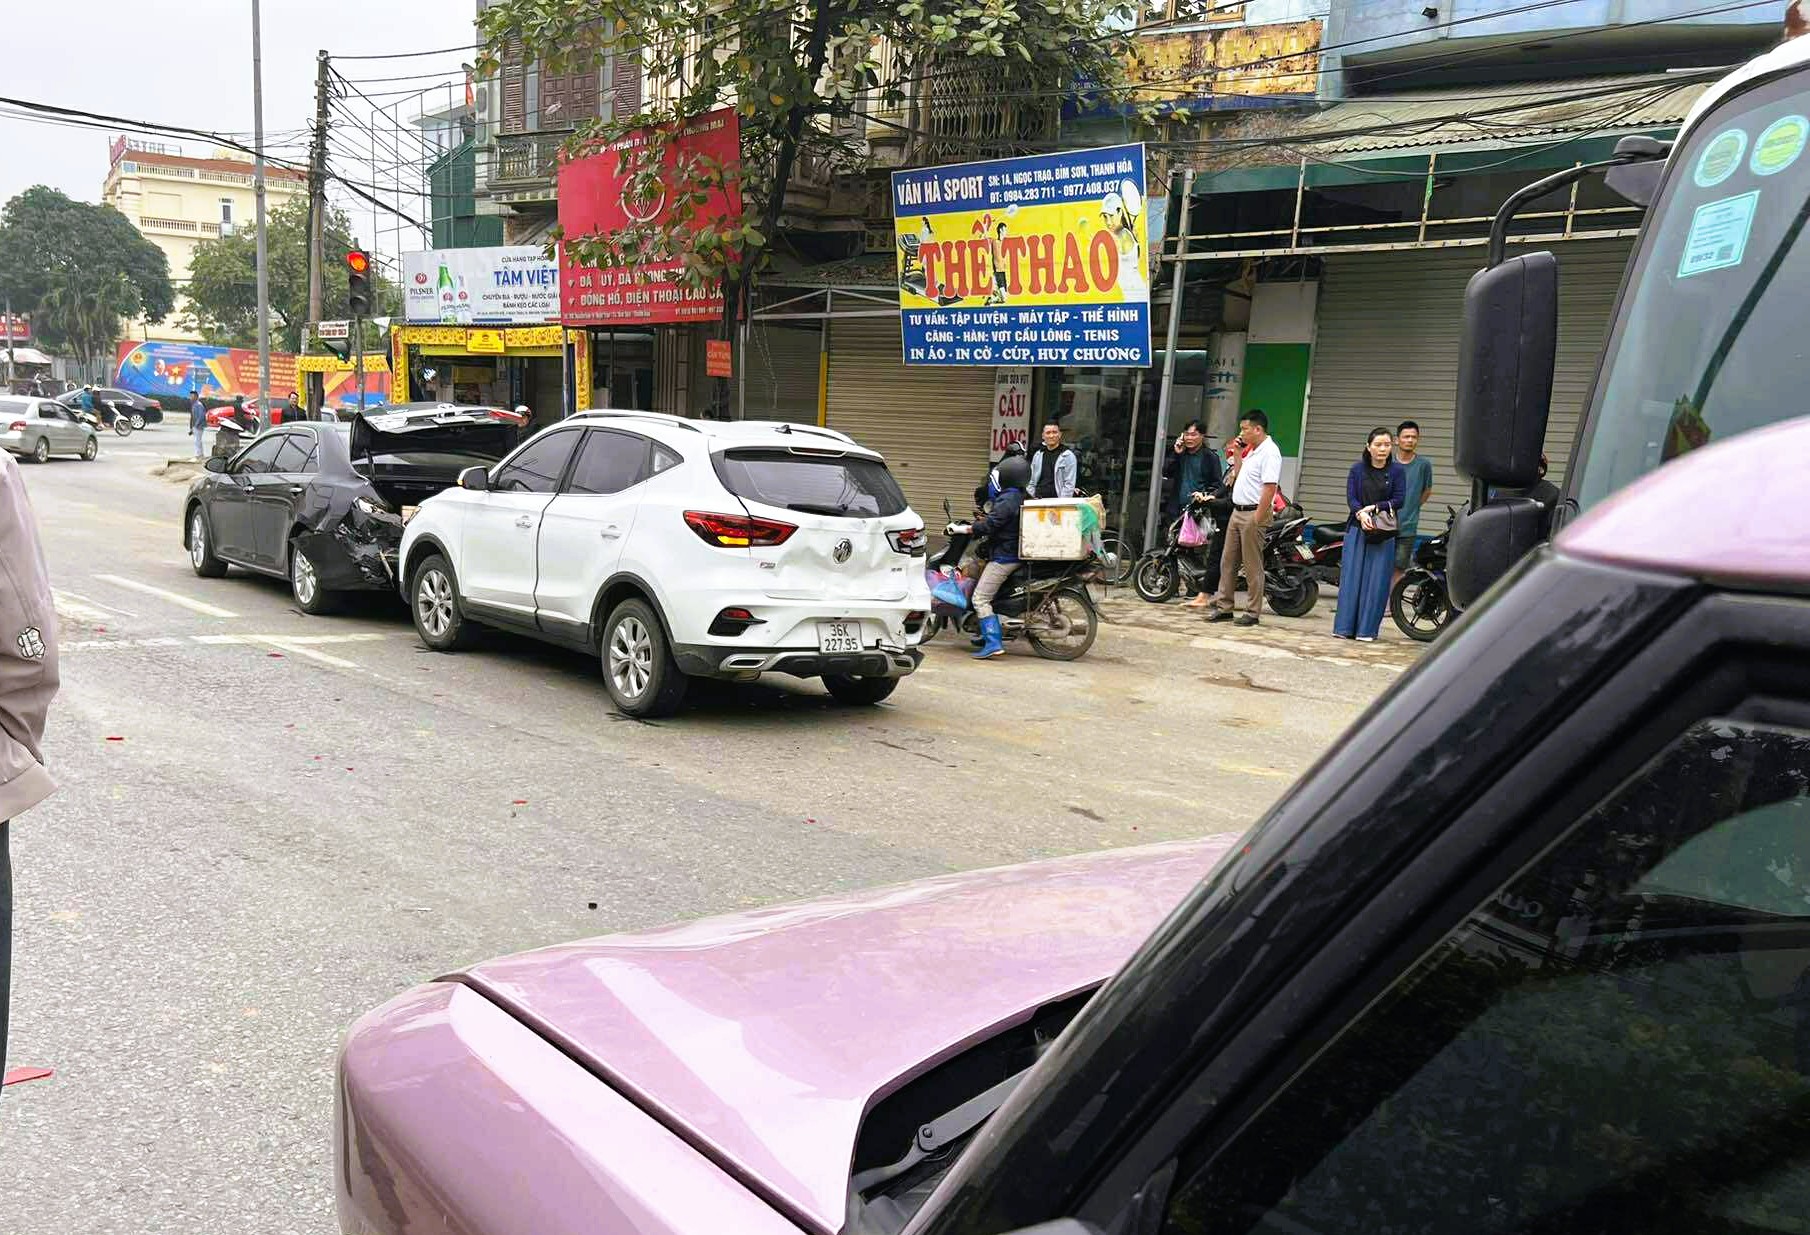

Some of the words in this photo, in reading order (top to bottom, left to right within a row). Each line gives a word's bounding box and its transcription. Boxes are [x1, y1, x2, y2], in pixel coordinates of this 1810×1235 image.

[988, 175, 1000, 187] SN:
[1002, 173, 1012, 185] 1A,
[1014, 170, 1032, 186] NGỌC
[1034, 170, 1054, 184] TRẠO,
[1071, 165, 1089, 179] SƠN,
[1090, 162, 1115, 176] THANH
[1117, 158, 1133, 173] HÓA
[897, 178, 922, 205] VÂN
[924, 175, 941, 203] HÀ
[944, 175, 983, 202] SPORT
[1041, 186, 1055, 199] 711
[918, 213, 995, 299] THỂ
[1001, 230, 1119, 297] THAO
[494, 266, 522, 286] TÂM
[526, 265, 558, 289] VIỆT
[653, 287, 682, 304] THOẠI
[925, 309, 948, 325] VẤN:
[951, 311, 971, 327] TẬP
[973, 310, 1008, 326] LUYỆN
[1018, 309, 1044, 324] MÁY
[1047, 309, 1070, 325] TẬP
[1081, 306, 1104, 322] THỂ
[1107, 307, 1138, 322] HÌNH
[963, 329, 989, 342] HÀN:
[992, 330, 1011, 344] VỢT
[1014, 327, 1038, 342] CẦU
[1041, 328, 1071, 342] LÔNG
[1083, 329, 1119, 342] TENIS
[910, 348, 924, 360] IN
[928, 345, 946, 360] ÁO
[955, 348, 970, 360] IN
[973, 345, 992, 360] CỜ
[1002, 345, 1035, 362] CÚP,
[1038, 348, 1069, 360] HUY
[1073, 347, 1141, 361] CHƯƠNG
[999, 385, 1026, 417] CẦU
[993, 423, 1027, 451] LÔNG
[830, 623, 849, 637] 36K
